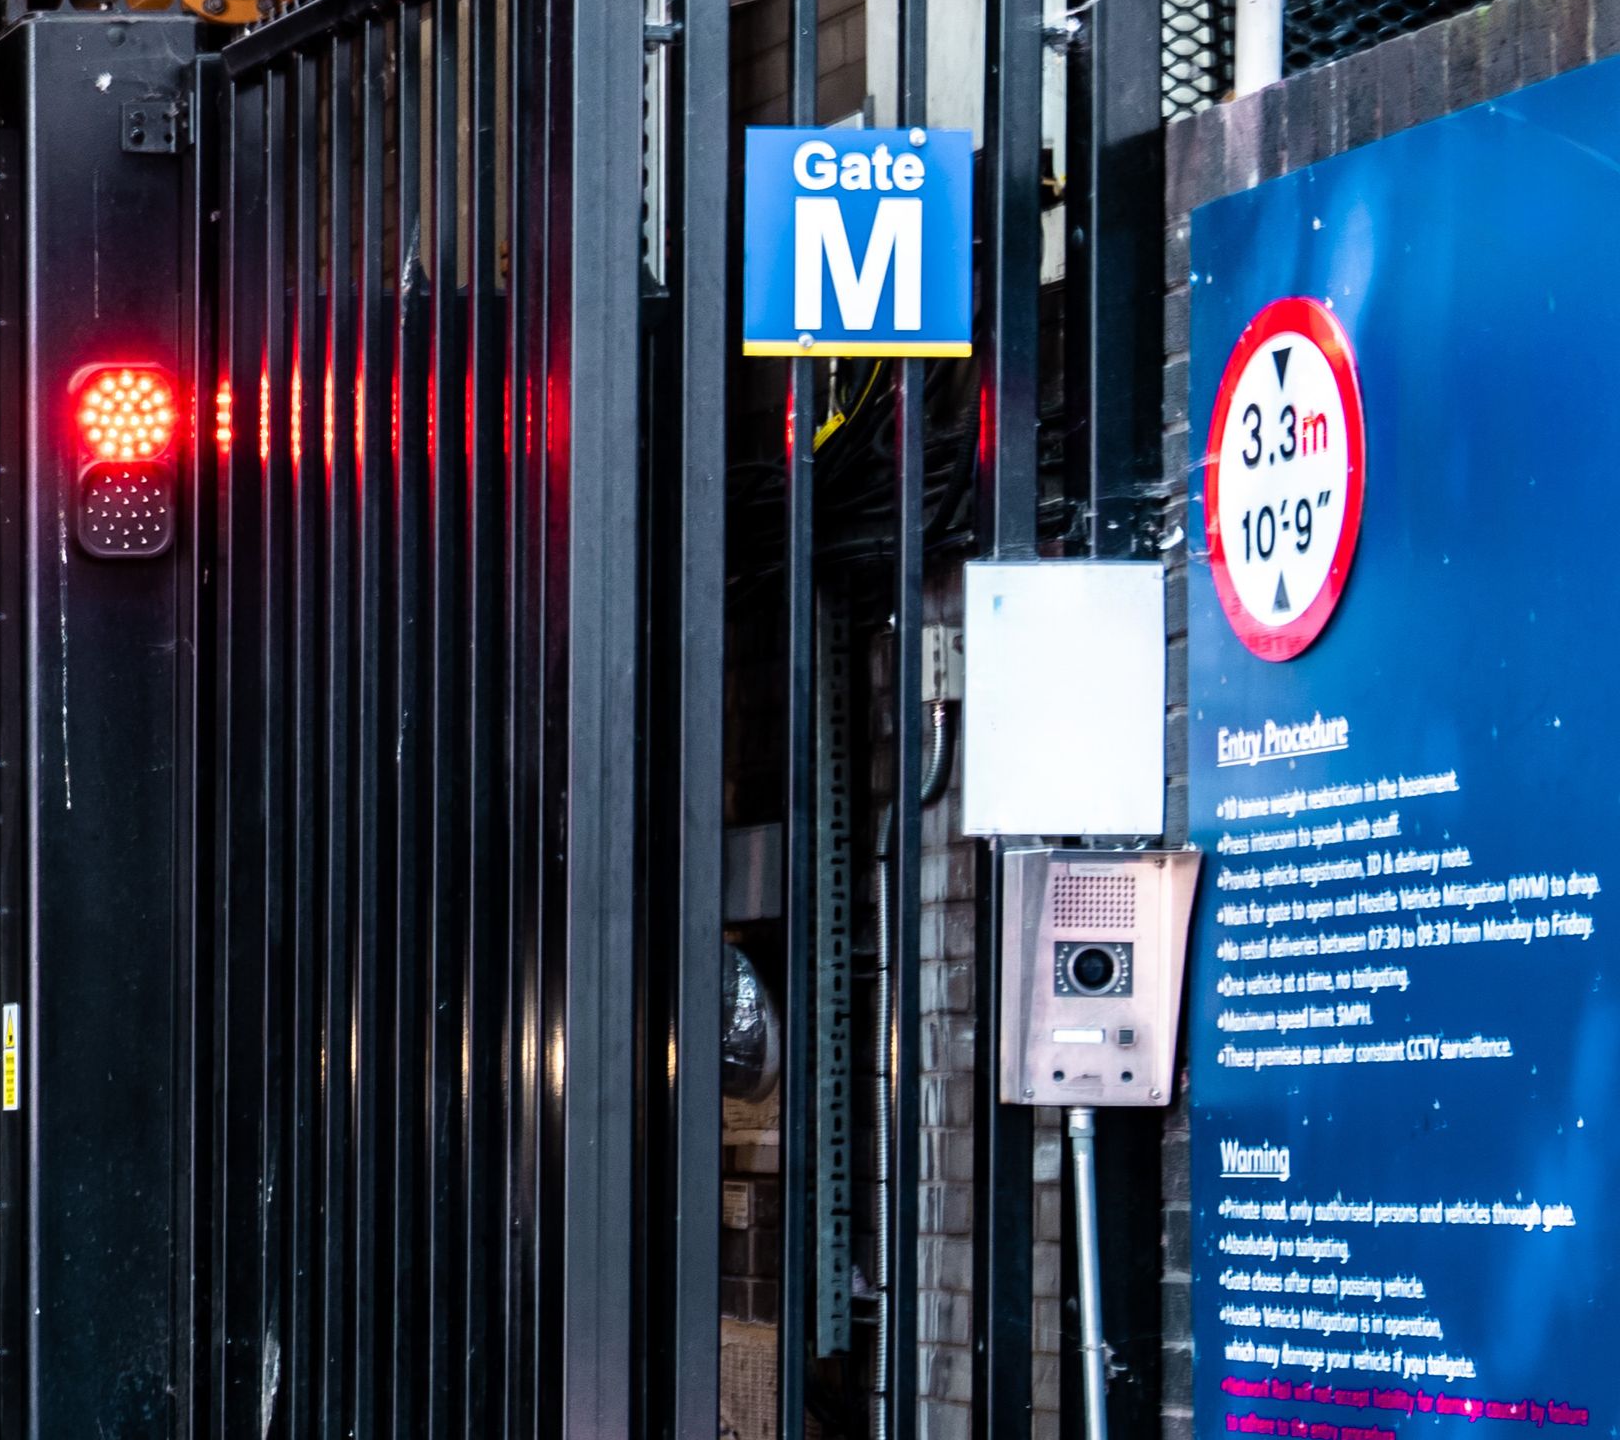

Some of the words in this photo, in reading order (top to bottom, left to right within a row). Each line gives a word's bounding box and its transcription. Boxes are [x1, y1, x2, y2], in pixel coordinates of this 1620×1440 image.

[793, 140, 925, 191] Gate
[794, 196, 923, 330] M
[1241, 403, 1328, 468] 3.3m
[1217, 727, 1262, 765] Entry
[1263, 710, 1349, 752] Procedure
[1221, 1138, 1290, 1181] Warning
